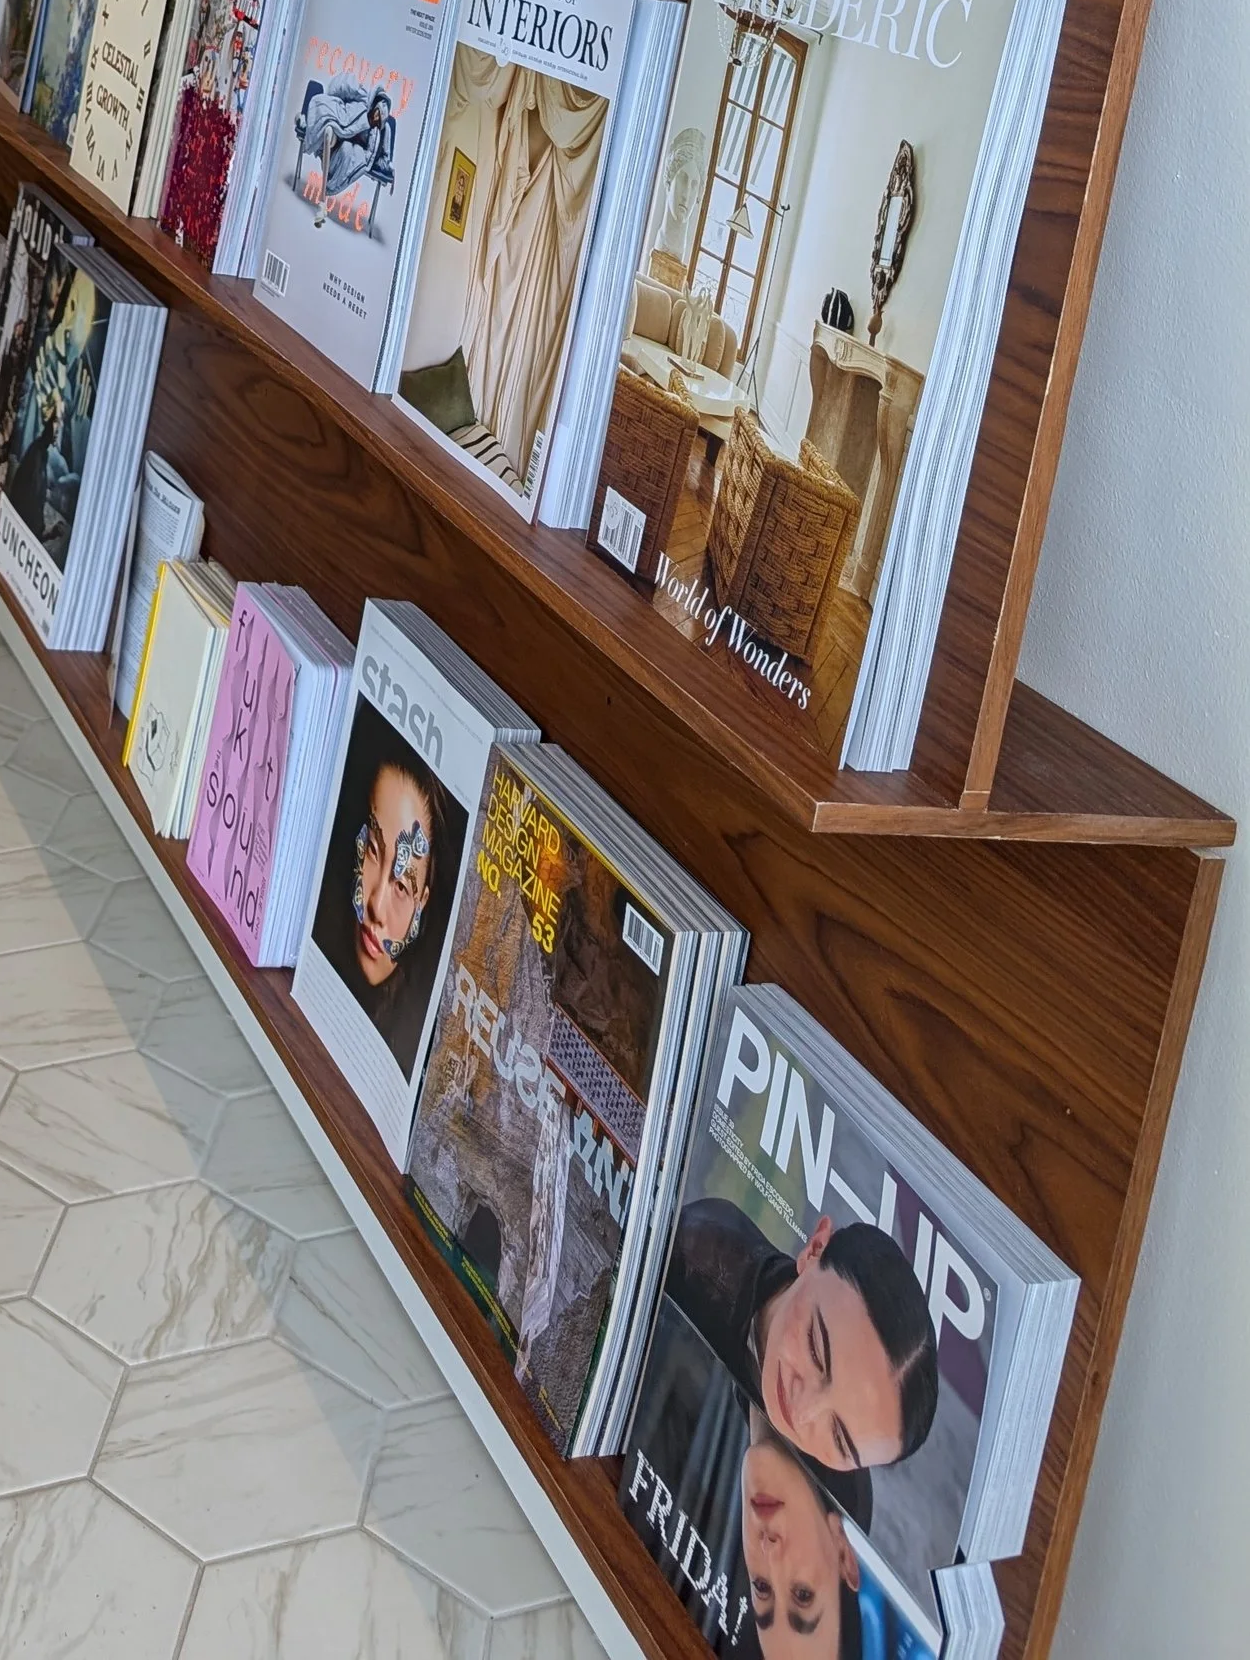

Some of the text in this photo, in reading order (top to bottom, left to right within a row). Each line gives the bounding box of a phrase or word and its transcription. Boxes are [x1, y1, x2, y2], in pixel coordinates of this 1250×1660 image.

[102, 40, 139, 89] CELESTIAL
[304, 36, 417, 118] recovery
[96, 84, 129, 131] GROWTH
[303, 170, 369, 232] mode
[322, 282, 367, 320] NEEDS A RESET
[329, 271, 366, 303] WHY DESIGN
[654, 550, 812, 711] World of Wonders
[362, 655, 443, 770] stash
[487, 792, 541, 870] DESIGN
[492, 764, 561, 855] HARVARD
[476, 849, 555, 954] NO. 53
[482, 819, 561, 924] MAGAZINE
[452, 962, 635, 1229] REUSE AN
[712, 1110, 744, 1148] DOMESTICITY
[713, 1102, 735, 1130] ISSUE 39
[709, 1126, 808, 1243] PHOTOGRAPHED BY WOLFGANG TILLMANS
[710, 1118, 794, 1217] GUEST EDITED BY FRIDA ESCOBEDO
